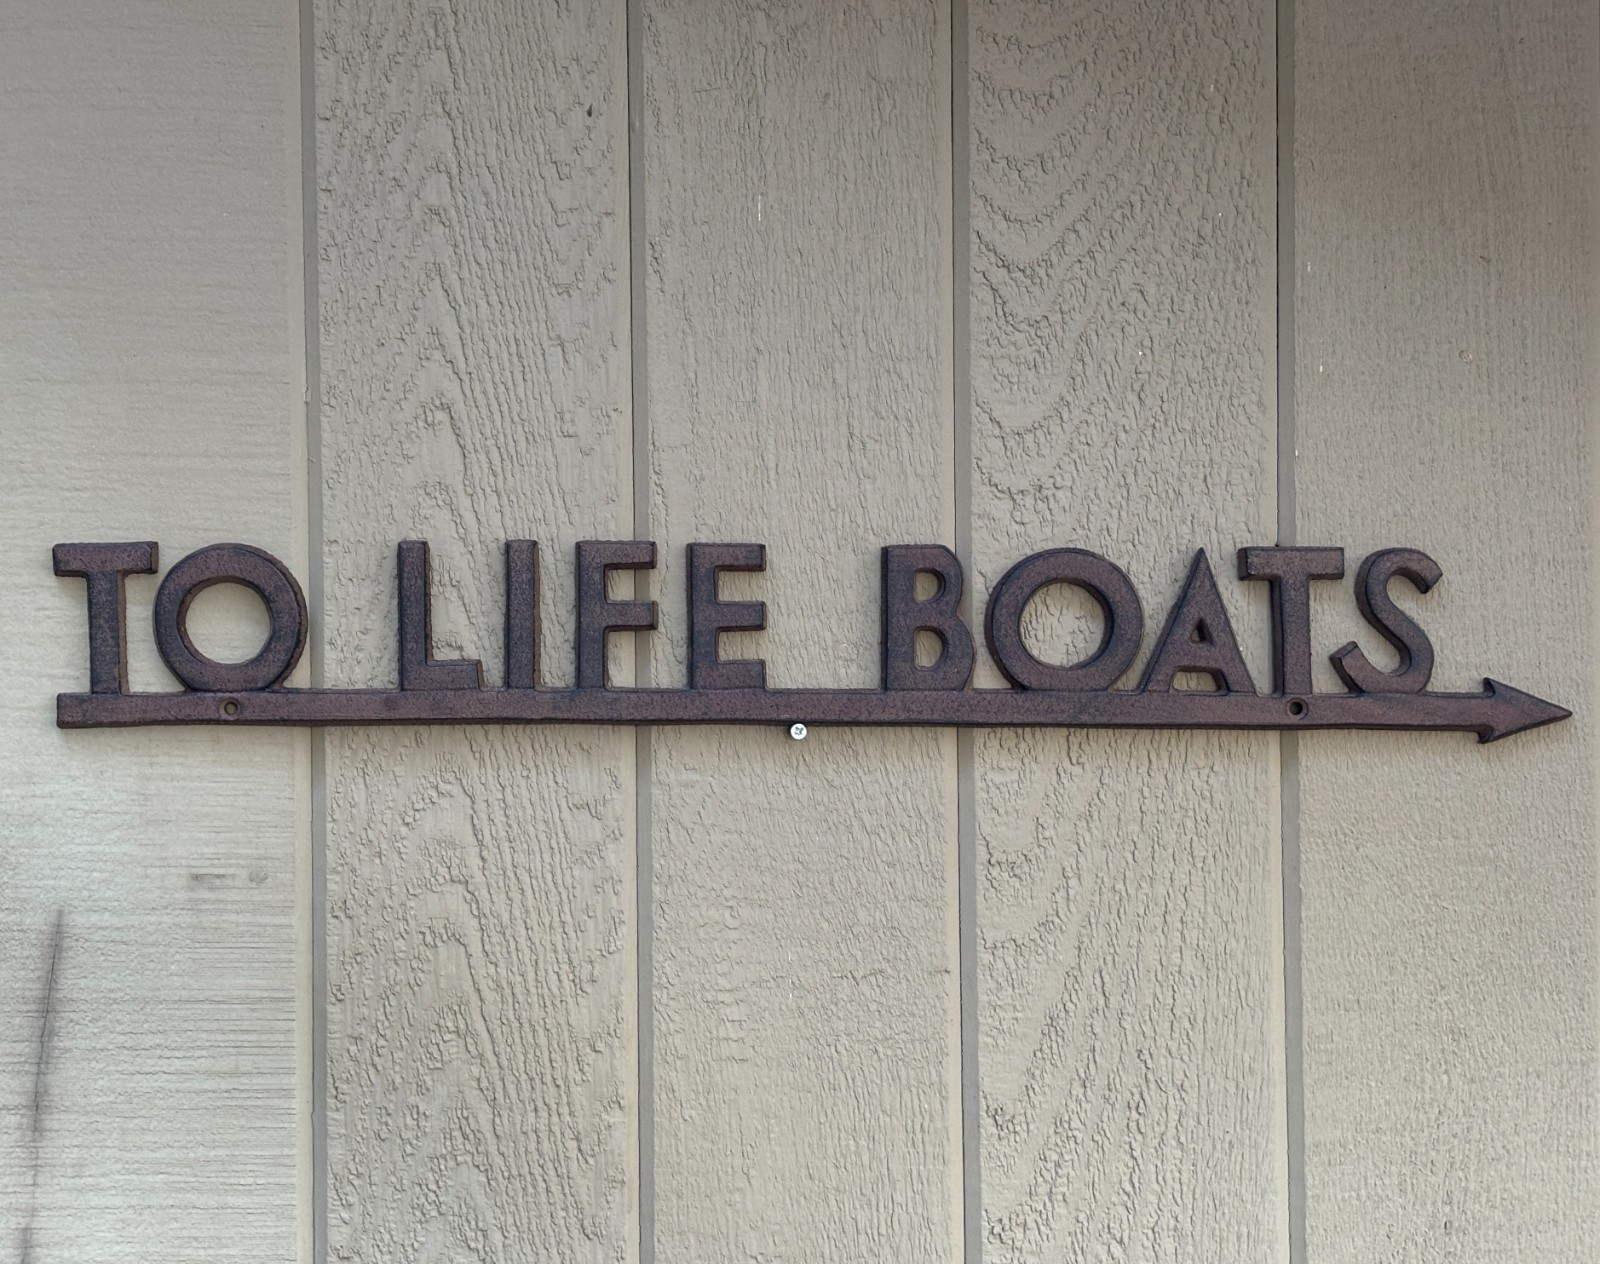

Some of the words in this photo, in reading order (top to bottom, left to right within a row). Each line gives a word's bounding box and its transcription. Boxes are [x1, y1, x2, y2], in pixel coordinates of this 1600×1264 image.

[53, 542, 306, 693] TO
[397, 540, 767, 691] LIFE
[881, 543, 1442, 695] BOATS
